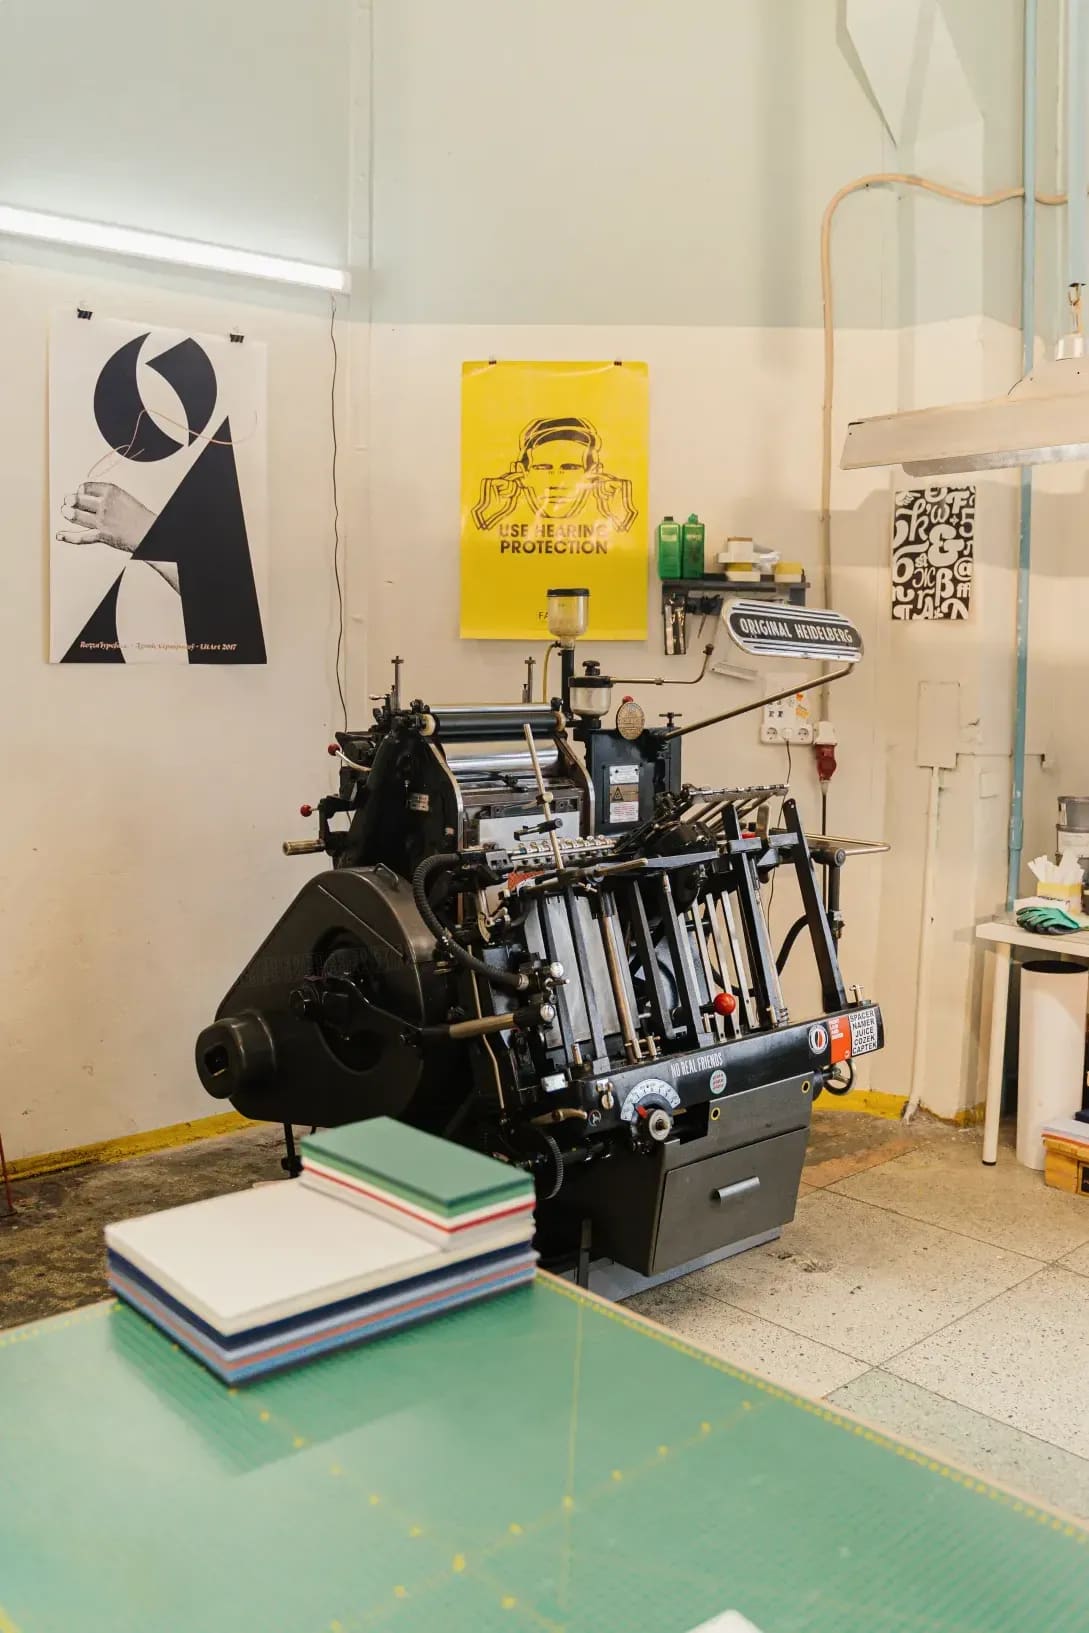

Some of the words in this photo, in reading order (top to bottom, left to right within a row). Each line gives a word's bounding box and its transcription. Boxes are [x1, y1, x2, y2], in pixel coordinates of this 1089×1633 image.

[500, 524, 528, 538] USE
[536, 524, 609, 538] HEARING
[500, 540, 608, 554] PROTECTION
[739, 617, 793, 638] ORIGINAL
[794, 623, 853, 643] HEIDELBERG
[855, 1027, 874, 1038] JUICE
[670, 1063, 681, 1078] NO
[681, 1059, 697, 1076] REAL
[697, 1053, 723, 1072] FRIENDS
